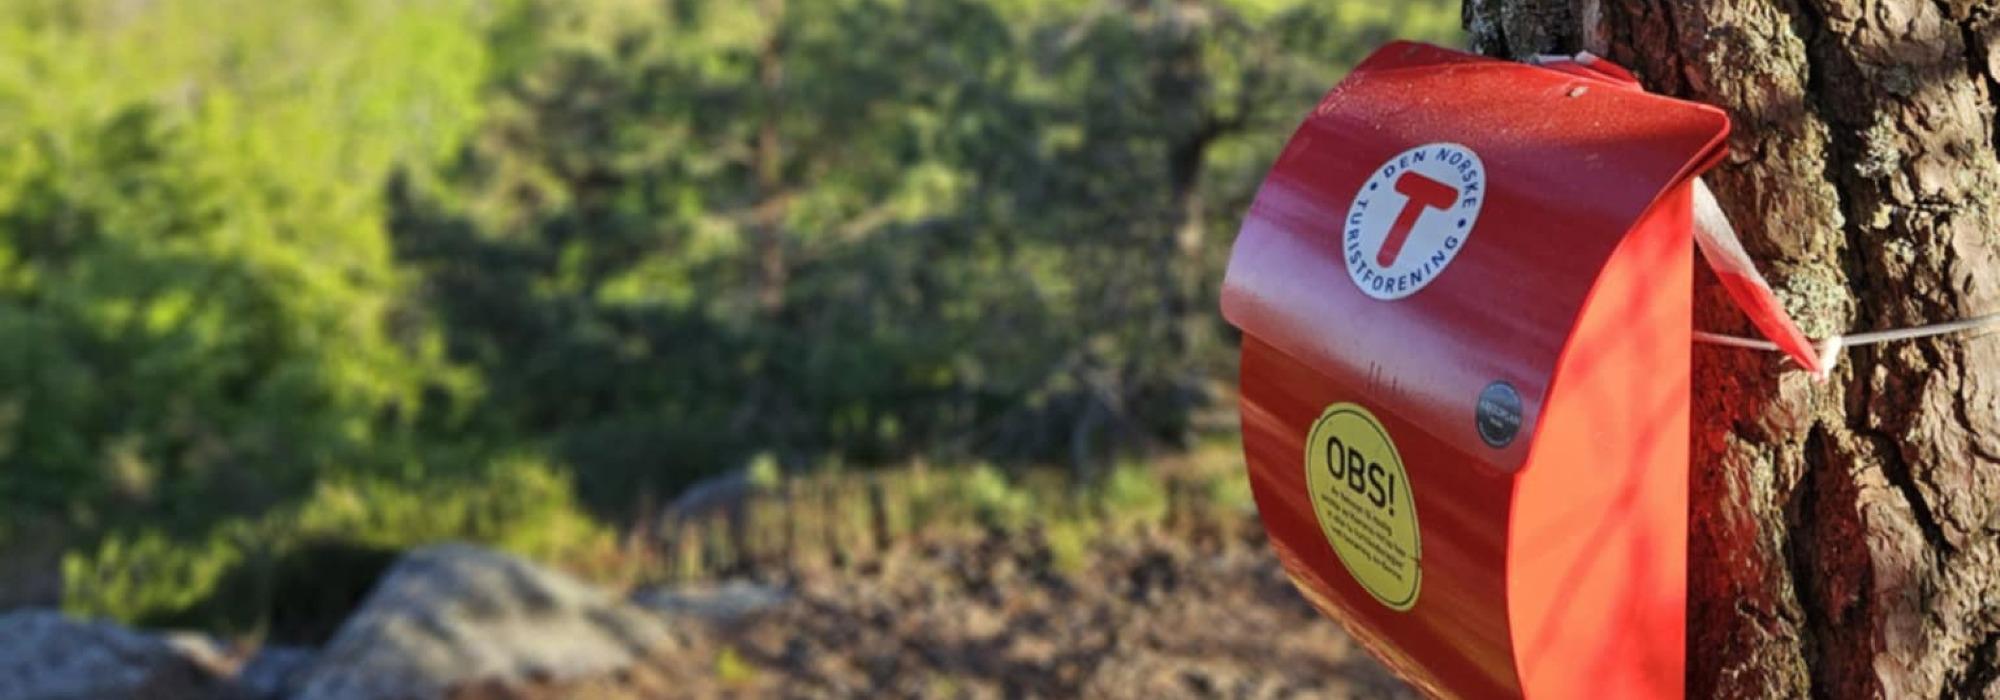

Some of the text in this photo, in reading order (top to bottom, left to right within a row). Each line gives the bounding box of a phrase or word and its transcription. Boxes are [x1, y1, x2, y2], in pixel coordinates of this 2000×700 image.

[1383, 147, 1479, 209] DEN NORSKE
[1347, 199, 1459, 293] TURISTFORENING
[1327, 435, 1395, 517] OBS!
